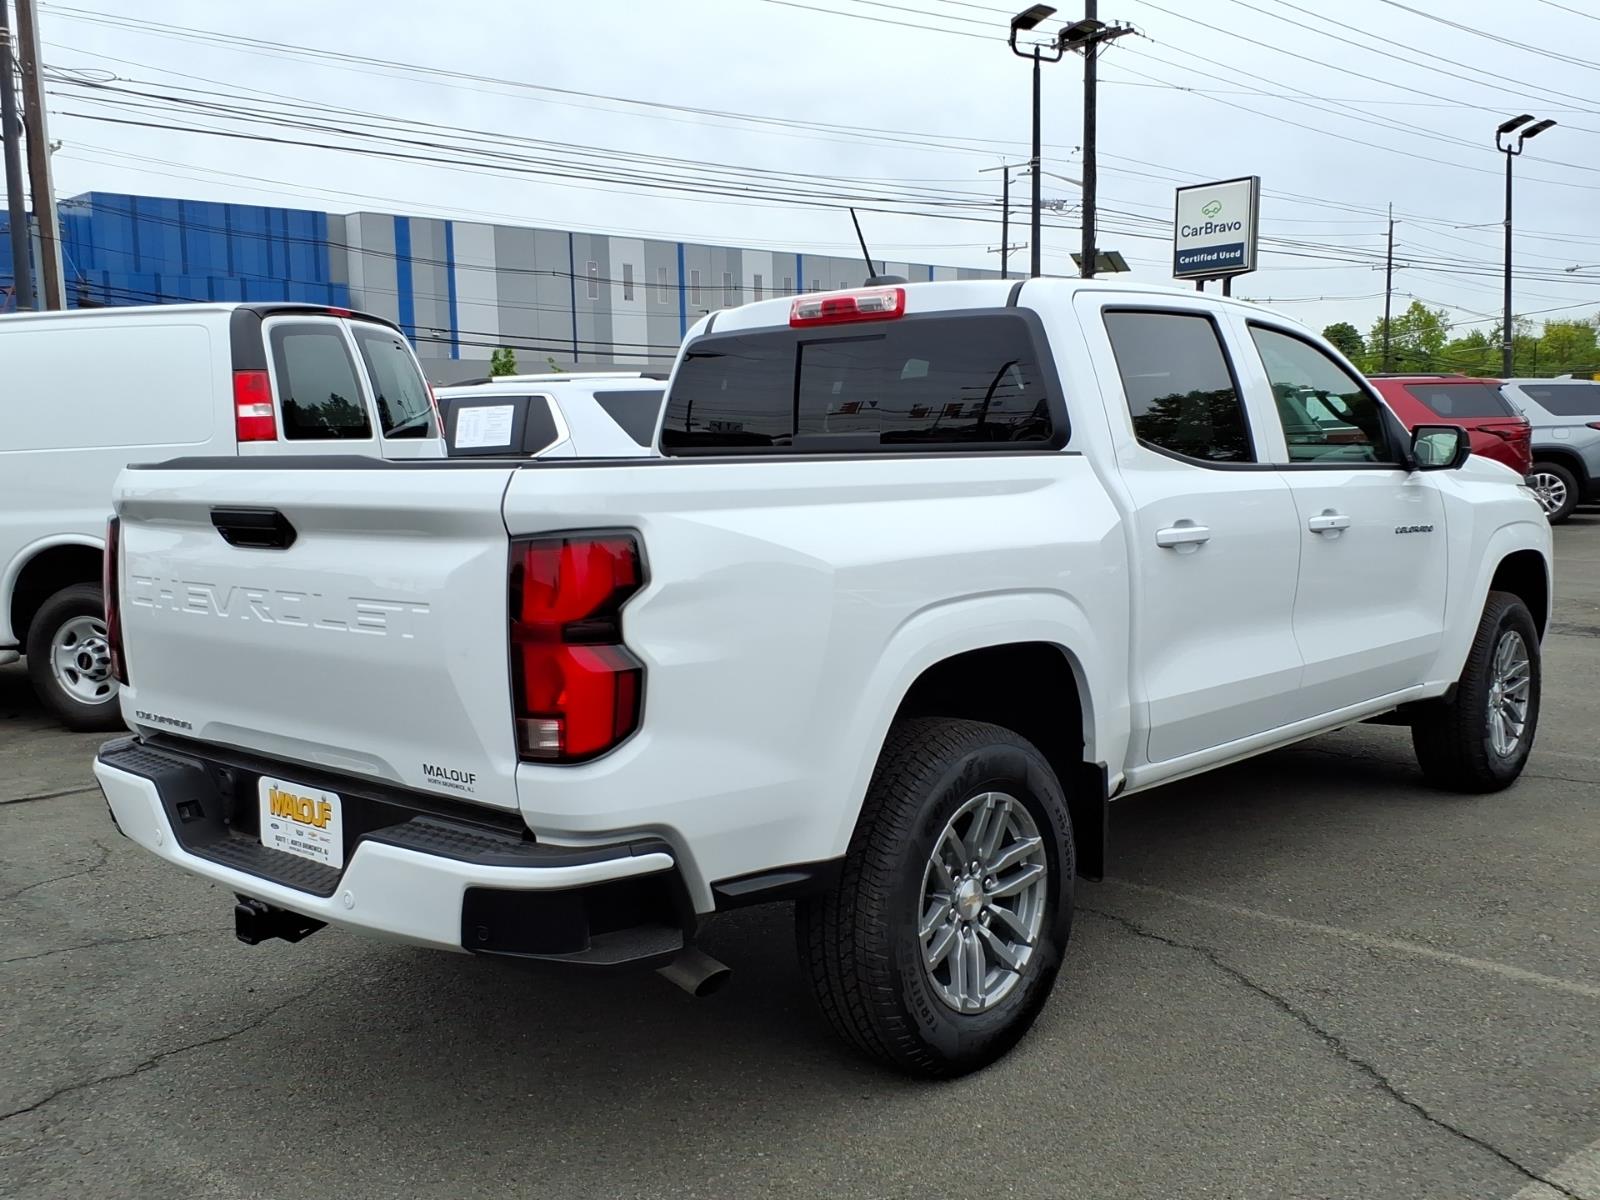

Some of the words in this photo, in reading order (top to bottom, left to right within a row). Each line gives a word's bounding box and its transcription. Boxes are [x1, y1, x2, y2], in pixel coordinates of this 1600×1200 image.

[1181, 221, 1242, 238] CarBravo
[1179, 252, 1218, 264] Certified
[1219, 249, 1241, 260] Used
[131, 575, 430, 639] CHEVROLET
[422, 763, 477, 785] MALOUF
[269, 788, 332, 829] MALOUF
